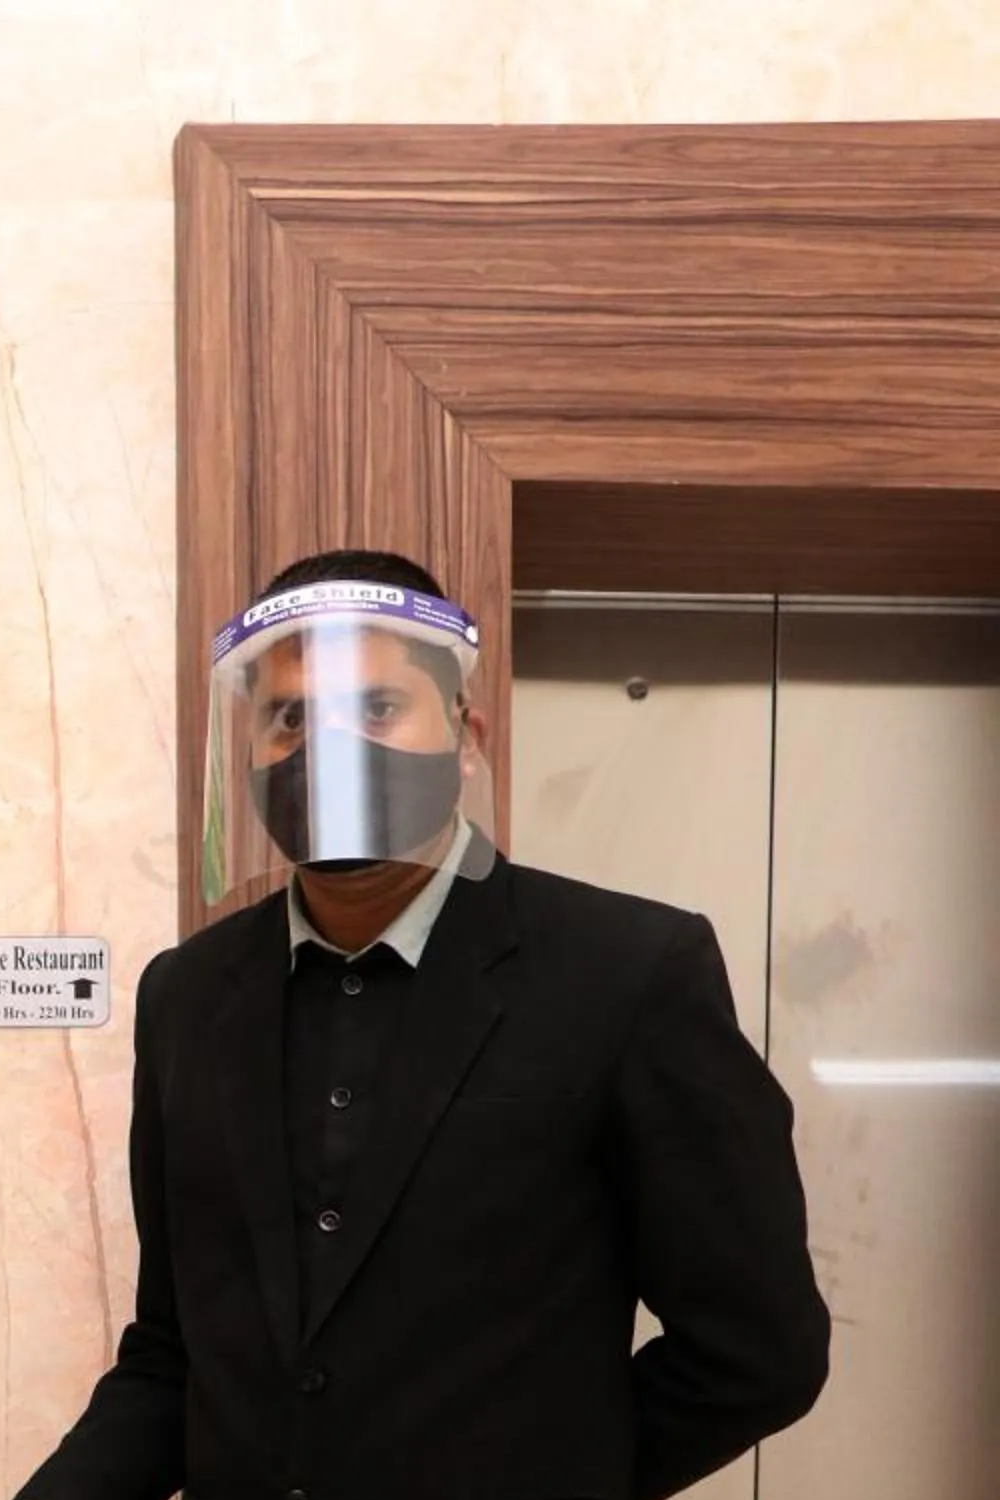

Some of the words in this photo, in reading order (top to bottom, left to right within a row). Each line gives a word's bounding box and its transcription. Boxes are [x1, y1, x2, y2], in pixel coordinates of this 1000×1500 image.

[248, 594, 301, 621] Face
[311, 586, 399, 602] Shield
[13, 946, 105, 971] Restaurant
[3, 1006, 28, 1020] Hrs
[38, 1005, 67, 1020] 2230
[70, 1005, 95, 1020] Hrs
